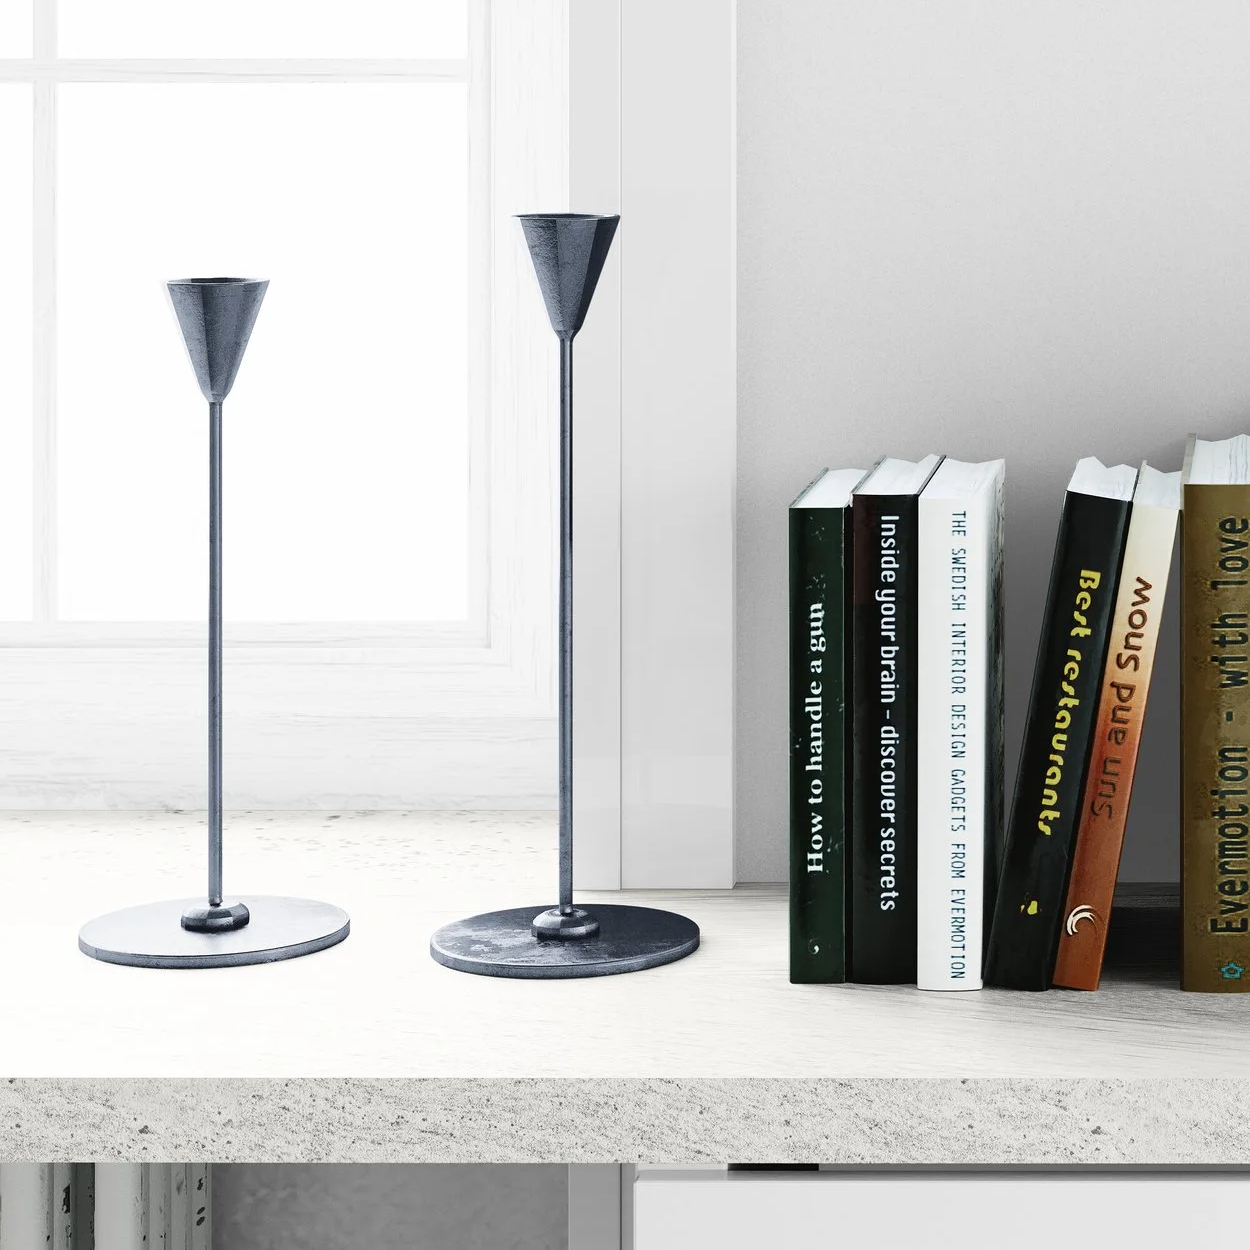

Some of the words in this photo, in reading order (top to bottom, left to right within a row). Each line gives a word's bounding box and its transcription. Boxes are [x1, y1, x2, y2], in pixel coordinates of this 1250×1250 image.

[881, 515, 900, 583] Inside
[951, 510, 967, 537] THE
[1211, 517, 1249, 597] love
[951, 548, 967, 611] SWEDISH
[1070, 569, 1101, 638] Best
[810, 602, 827, 653] gun
[874, 589, 896, 642] your
[1115, 575, 1154, 673] Snow
[810, 658, 823, 674] a
[880, 646, 900, 703] brain
[951, 622, 967, 694] INTERIOR
[1211, 611, 1249, 691] with
[804, 681, 823, 771] handle
[951, 704, 966, 758] DESIGN
[1037, 648, 1082, 836] restaurants
[1106, 680, 1137, 747] and
[807, 778, 823, 805] to
[880, 725, 900, 824] discover
[951, 768, 966, 832] GADGETS
[1090, 756, 1122, 820] Sun
[807, 812, 824, 873] How
[880, 827, 899, 911] secrets
[951, 843, 966, 879] FROM
[1210, 747, 1249, 938] Evermotion
[950, 889, 966, 979] EVERMOTION
